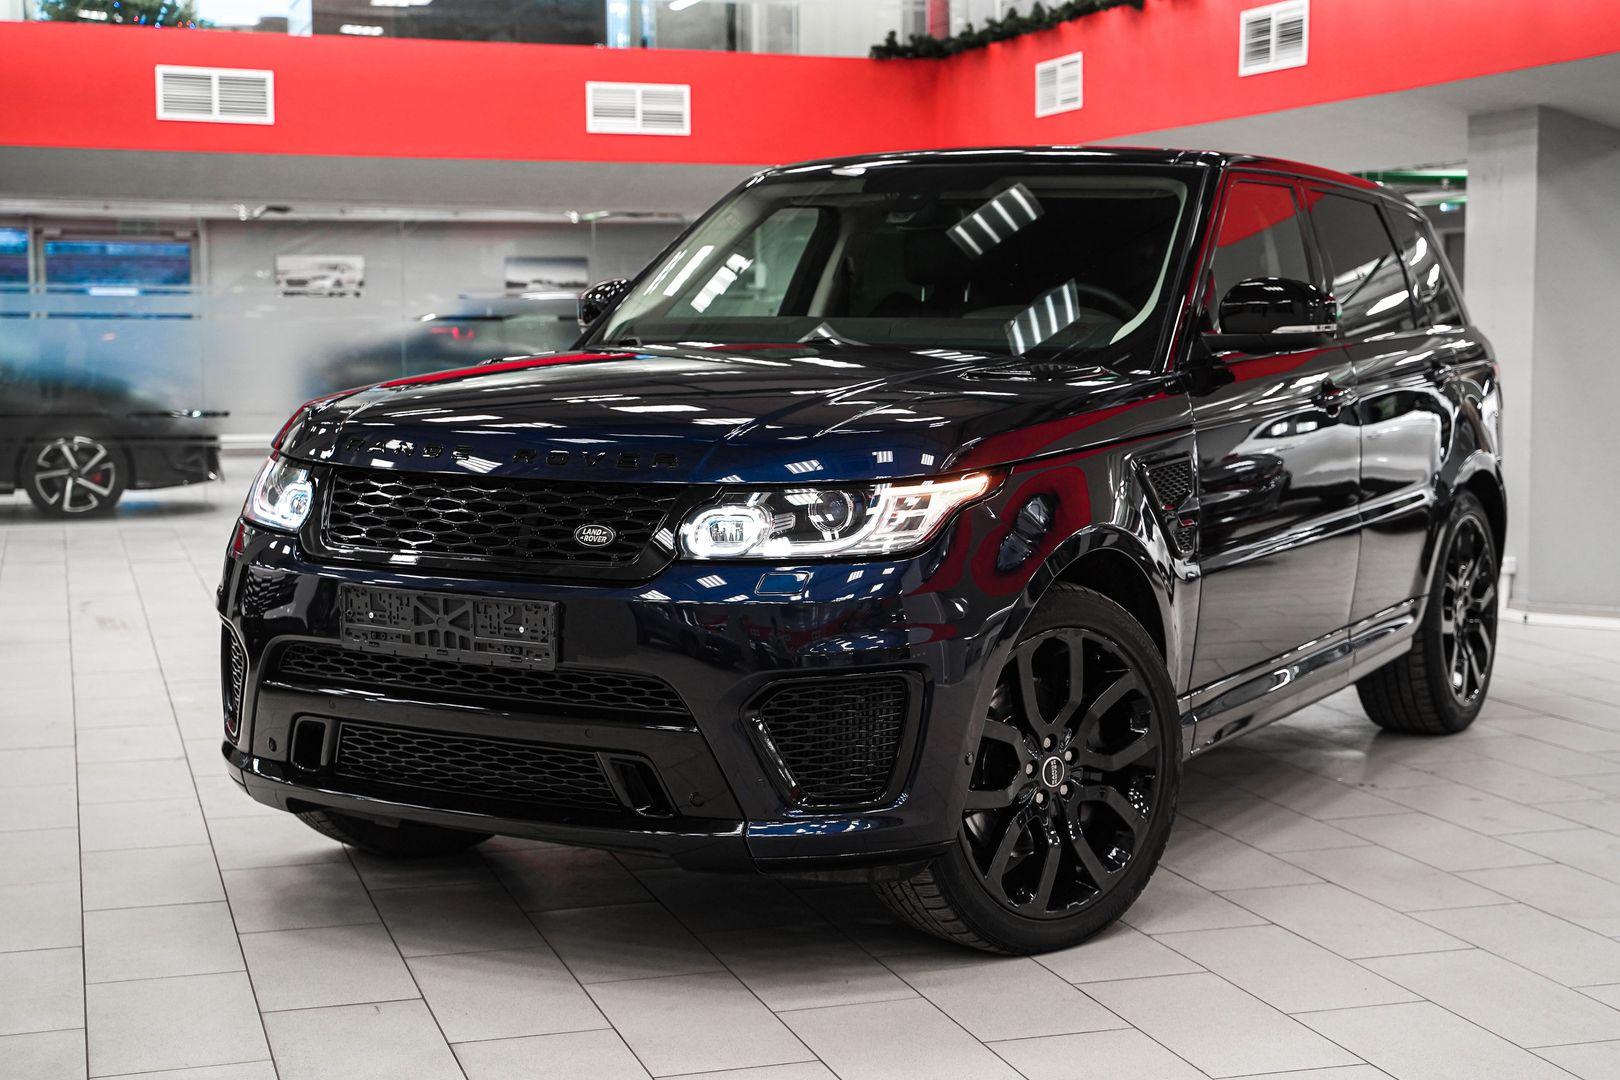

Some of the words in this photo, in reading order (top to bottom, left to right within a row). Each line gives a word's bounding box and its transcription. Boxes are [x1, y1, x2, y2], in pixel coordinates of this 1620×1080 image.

[344, 439, 472, 461] RANGE
[512, 449, 680, 469] ROVER
[583, 535, 607, 543] ROVER
